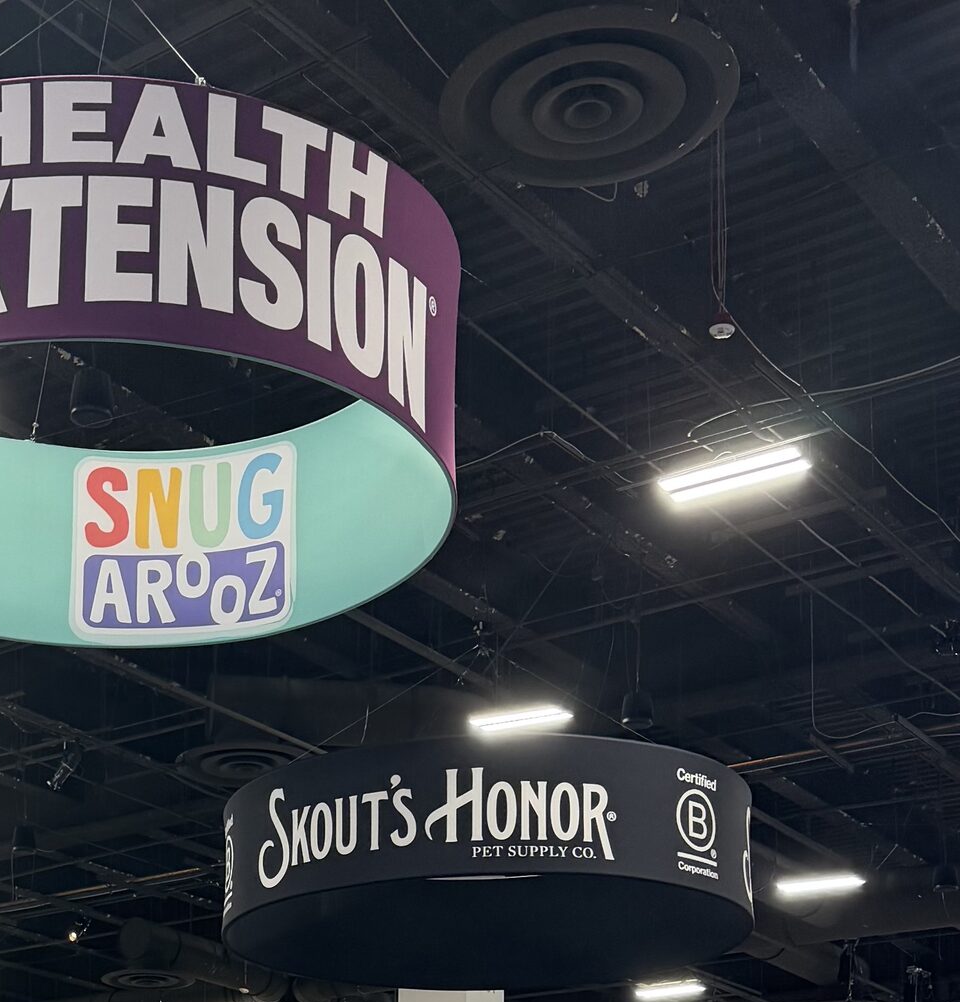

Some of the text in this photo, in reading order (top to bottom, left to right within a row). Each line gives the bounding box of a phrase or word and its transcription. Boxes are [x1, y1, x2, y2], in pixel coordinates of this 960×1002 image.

[84, 452, 284, 550] SNUG
[676, 767, 717, 792] Certified
[258, 774, 417, 888] SKOUT'S
[472, 845, 597, 860] PET SUPPLY CO.
[677, 860, 719, 880] Corporation
